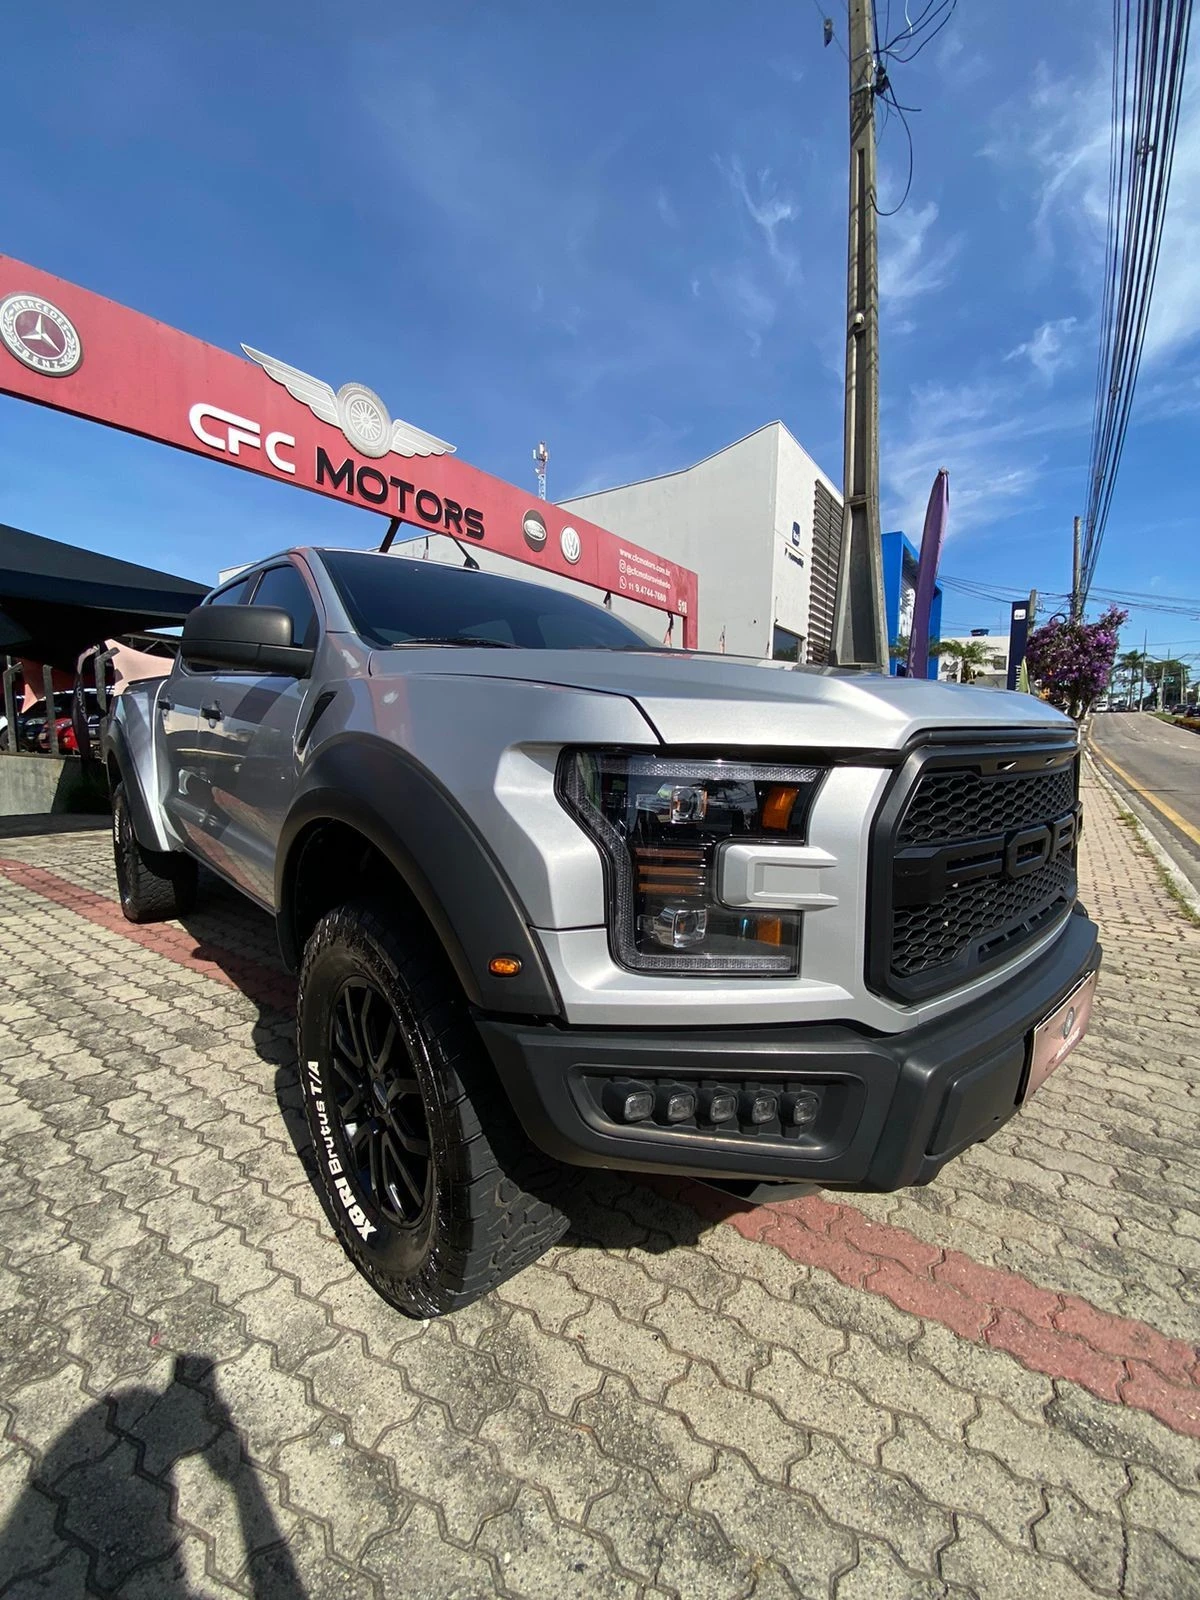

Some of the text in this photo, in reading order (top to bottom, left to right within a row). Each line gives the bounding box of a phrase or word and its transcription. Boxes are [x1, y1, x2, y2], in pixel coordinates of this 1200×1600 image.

[12, 300, 70, 331] MERCEDES
[21, 349, 61, 369] BENZ
[188, 403, 485, 540] CFC MOTORS
[307, 1060, 378, 1242] XBRI Brutus T/A
